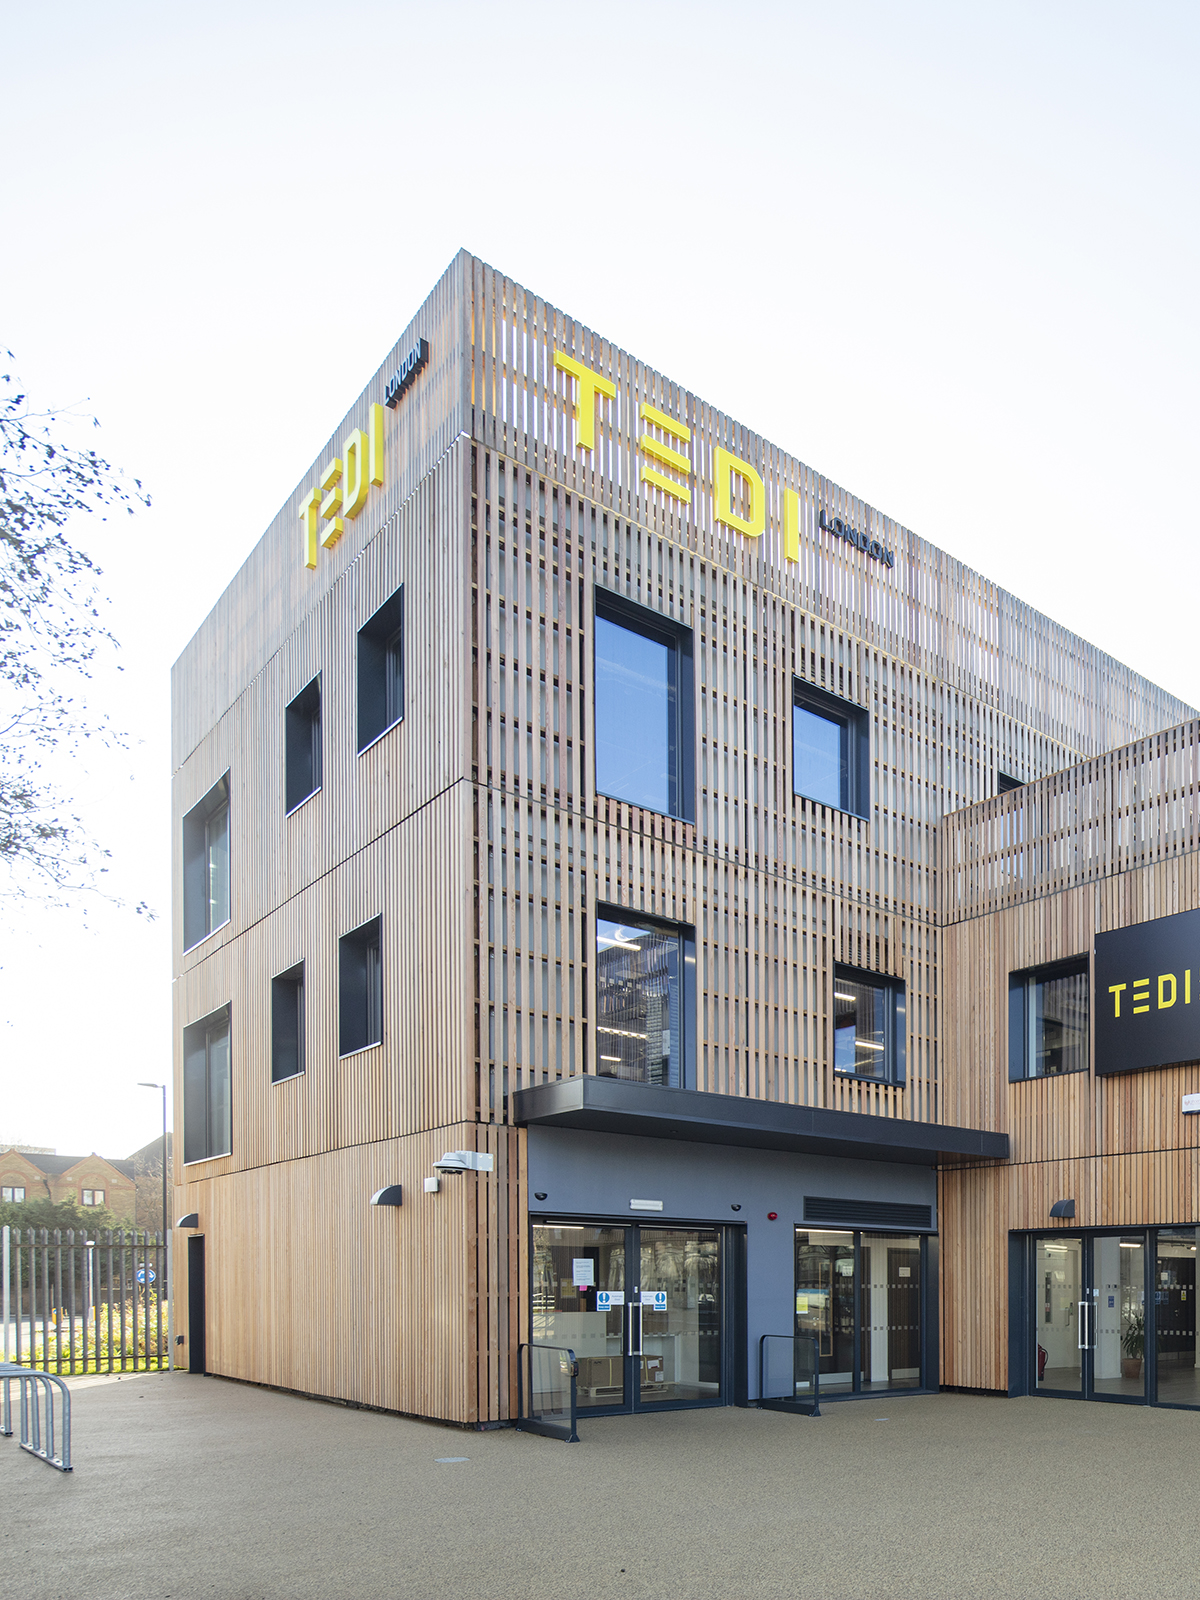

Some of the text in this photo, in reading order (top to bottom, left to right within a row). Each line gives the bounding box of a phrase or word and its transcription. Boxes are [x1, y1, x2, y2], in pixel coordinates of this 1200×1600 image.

[299, 337, 429, 570] TEDI LONDON
[554, 349, 894, 569] TEDI LONDON
[1108, 969, 1191, 1018] TEDI
